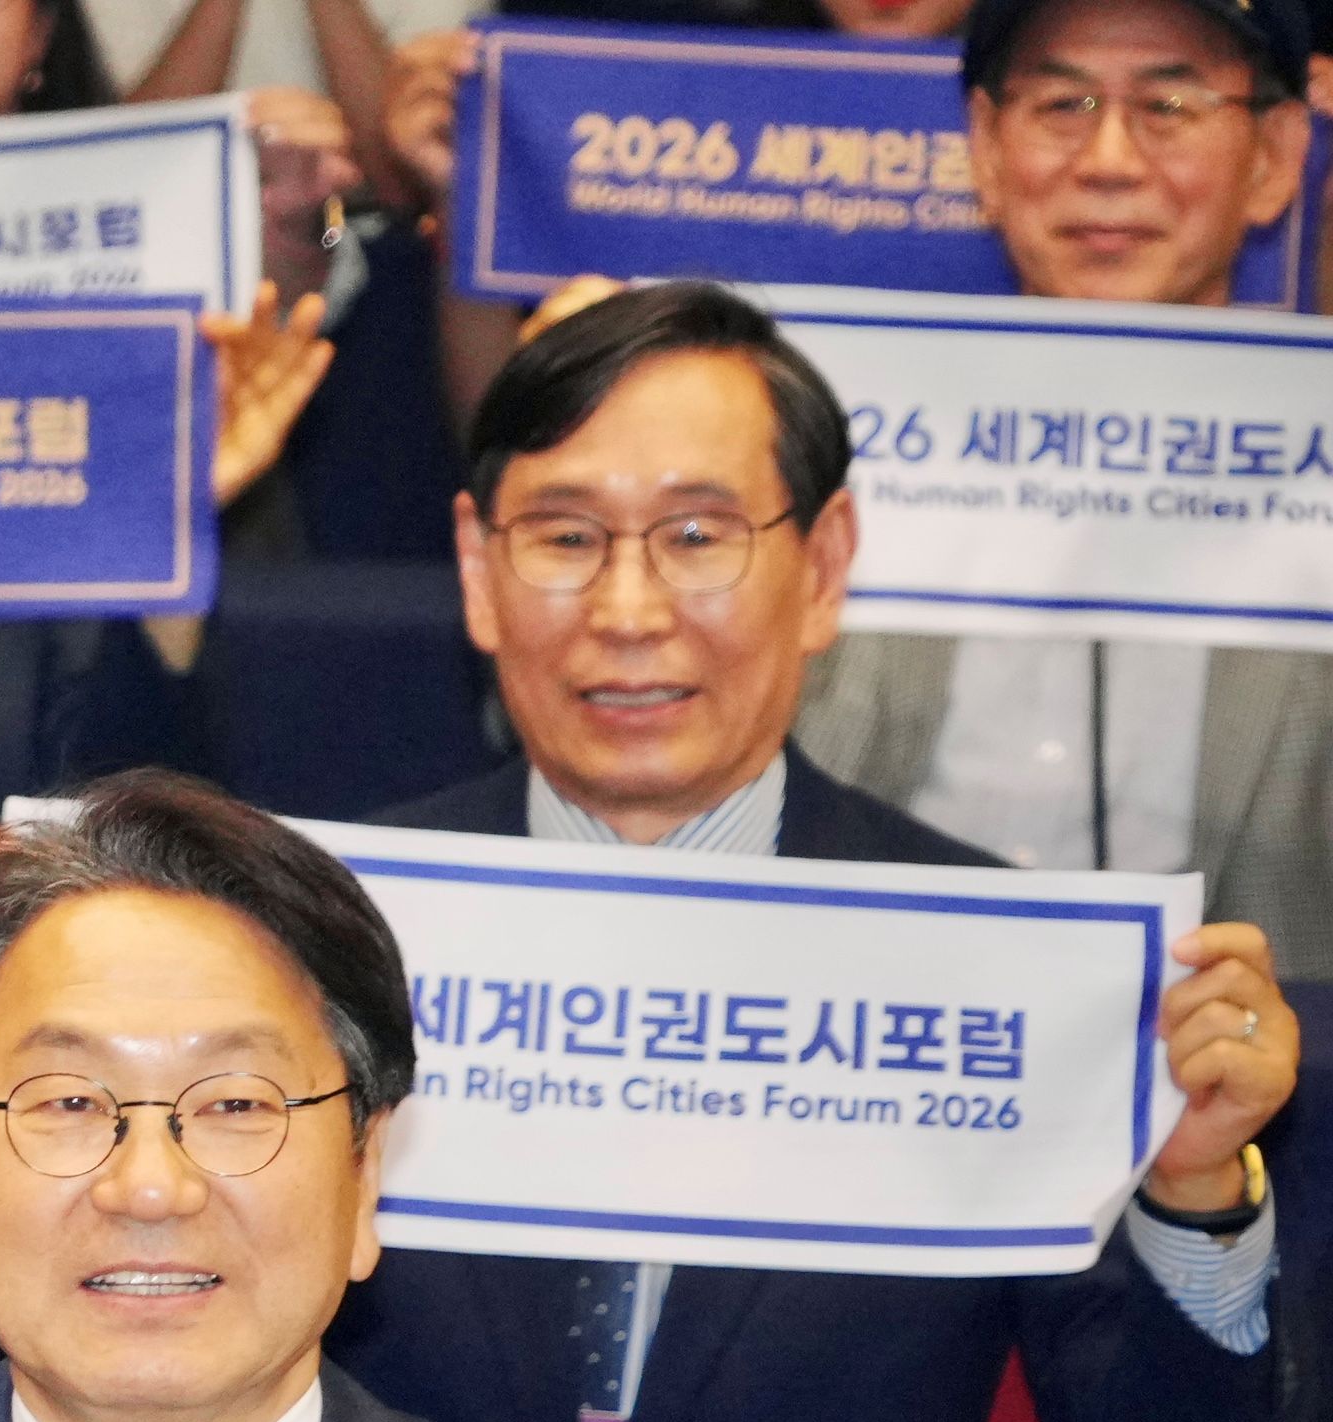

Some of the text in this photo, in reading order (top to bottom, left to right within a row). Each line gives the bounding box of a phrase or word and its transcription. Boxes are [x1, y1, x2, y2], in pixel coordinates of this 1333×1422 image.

[571, 112, 974, 192] 2026 세계인권
[851, 404, 1333, 477] 26 세계인권도시
[1016, 480, 1132, 520] Rights
[1144, 484, 1250, 521] Cities
[1263, 488, 1333, 524] For
[411, 974, 1026, 1081] 세계인권도시포럼
[465, 1065, 605, 1114] Rights
[620, 1076, 746, 1118] Cities
[763, 1082, 902, 1125] Forum
[915, 1091, 1024, 1131] 2026
